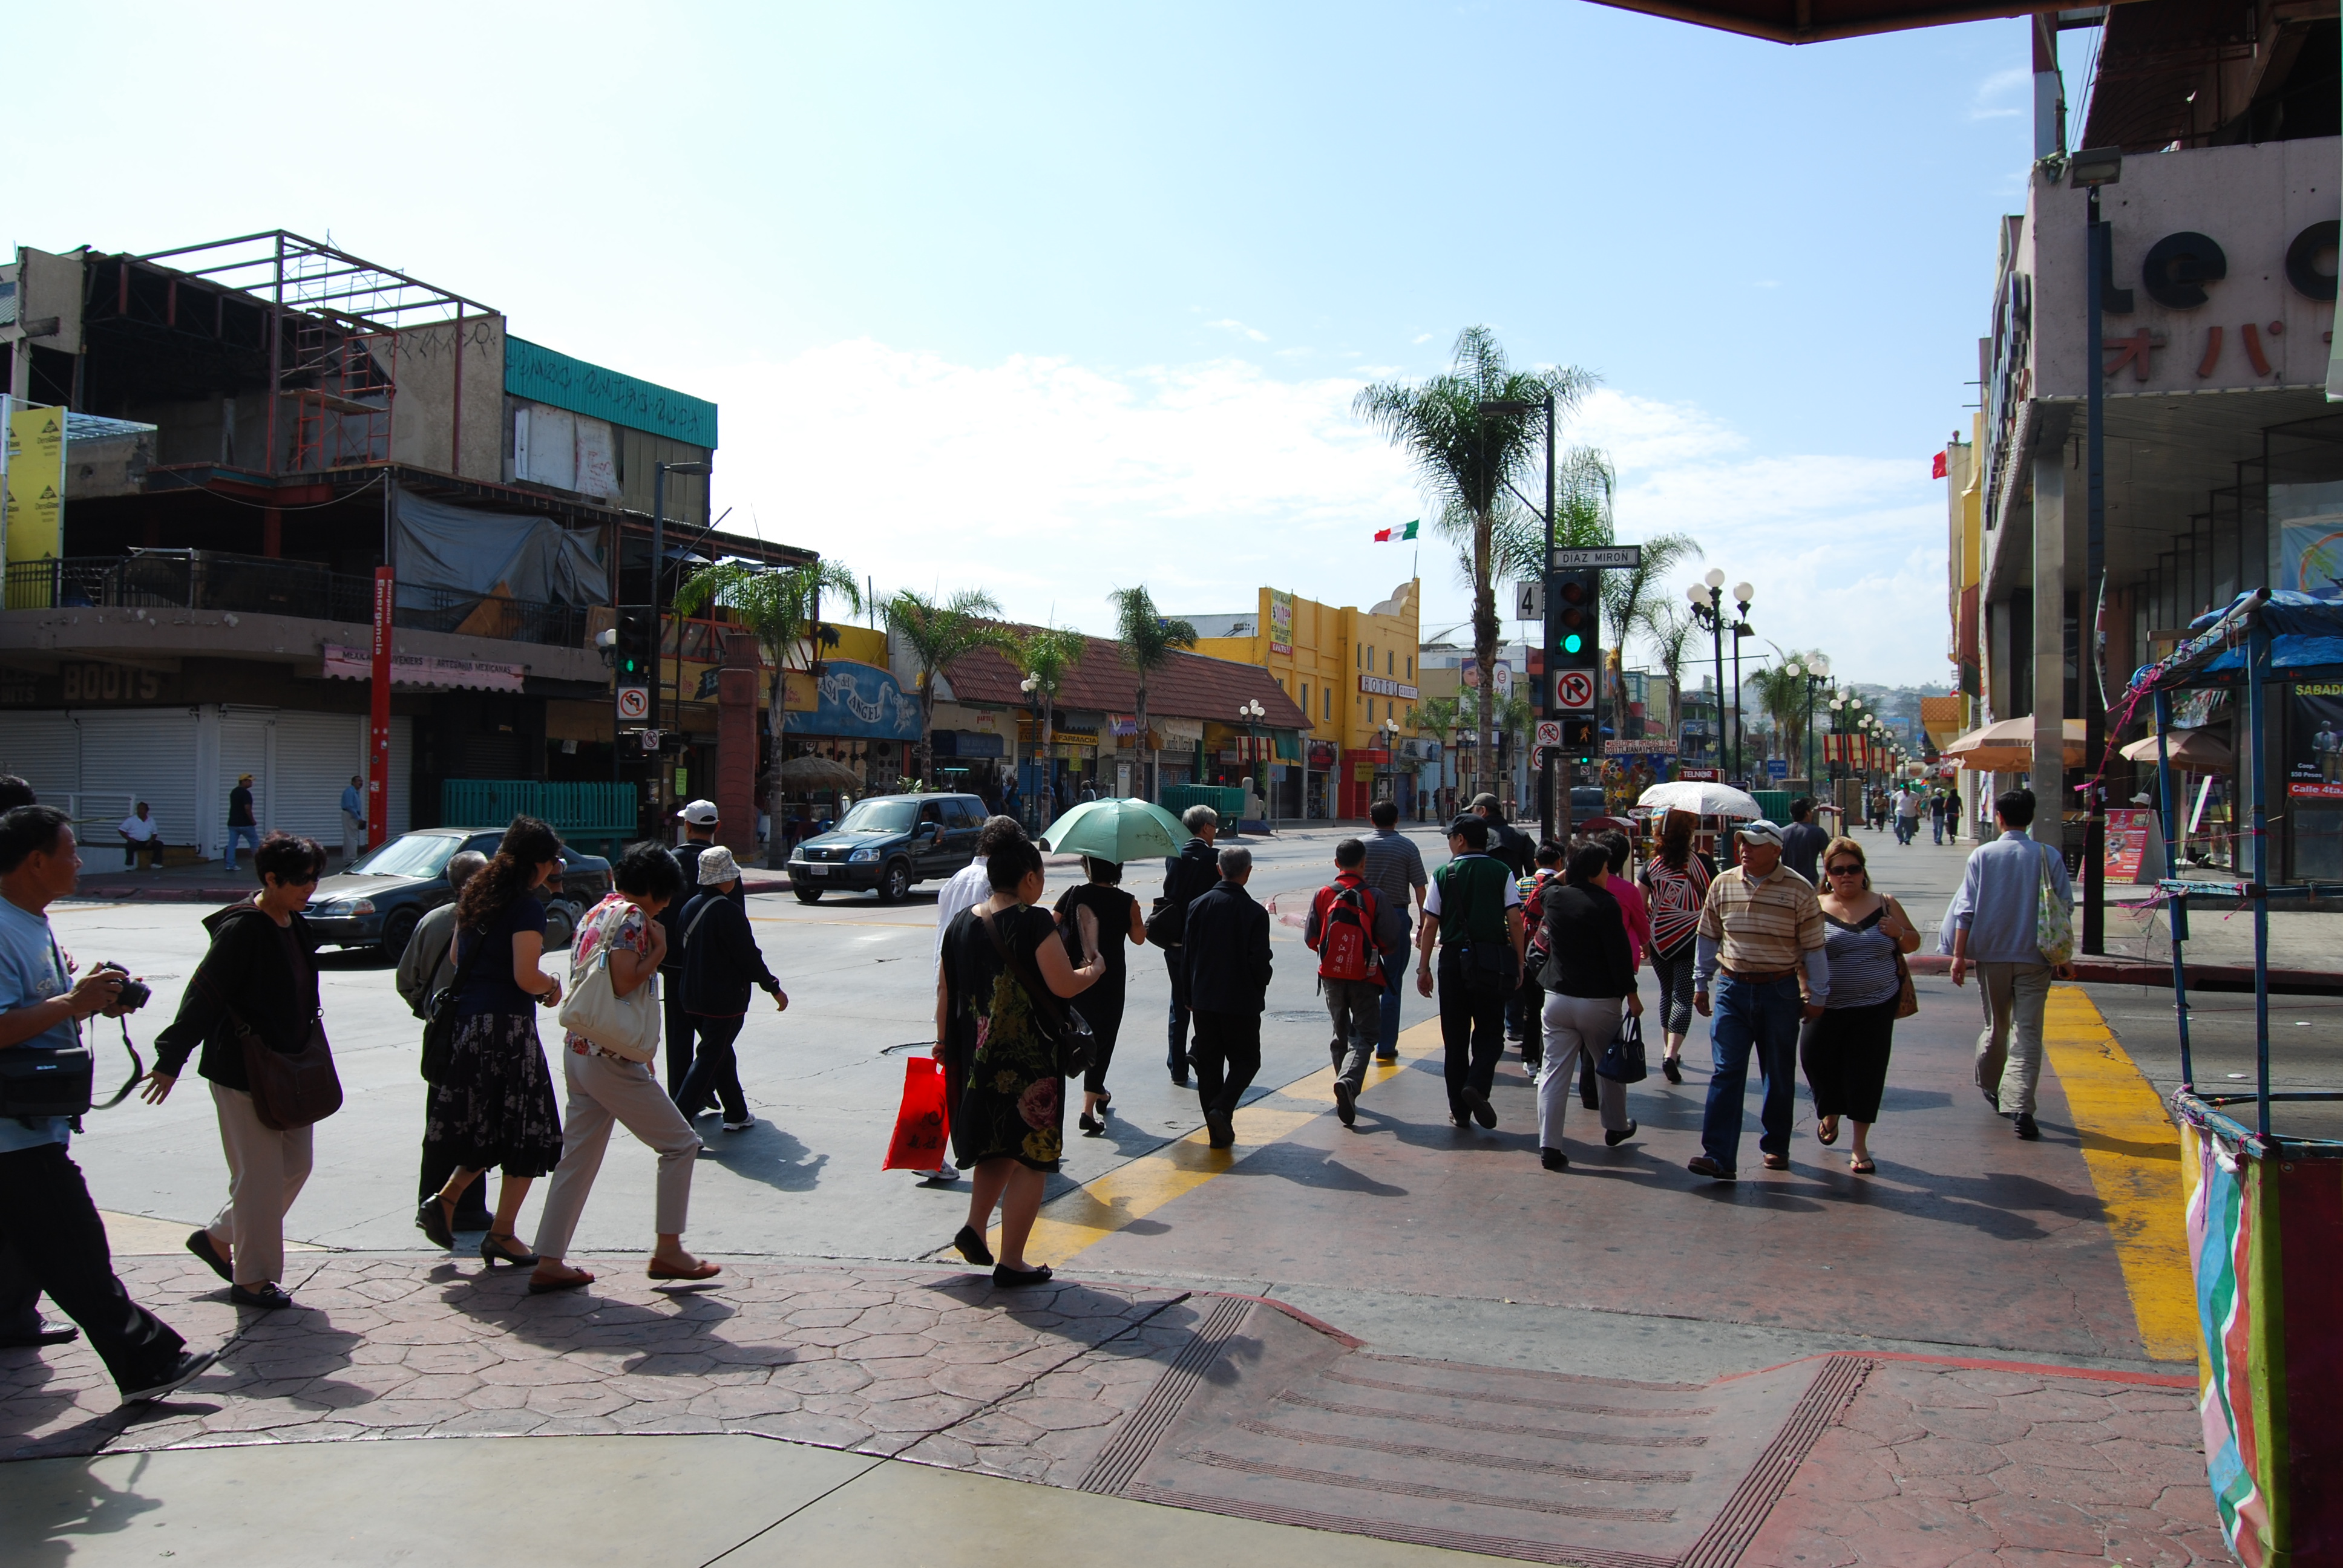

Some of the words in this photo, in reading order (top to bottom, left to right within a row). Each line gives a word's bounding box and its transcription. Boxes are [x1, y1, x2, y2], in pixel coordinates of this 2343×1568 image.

[1563, 554, 1588, 563] DIAZ
[1522, 587, 1533, 615] 4
[375, 579, 385, 655] Emergencia
[342, 651, 372, 661] MEXICA
[63, 664, 159, 700] BOOTS
[1365, 678, 1396, 695] HOTEL
[819, 679, 836, 701] ASA
[841, 677, 850, 687] del
[849, 696, 880, 720] ANGEL
[1059, 734, 1097, 744] FARMACIA
[2292, 785, 2319, 793] Calle
